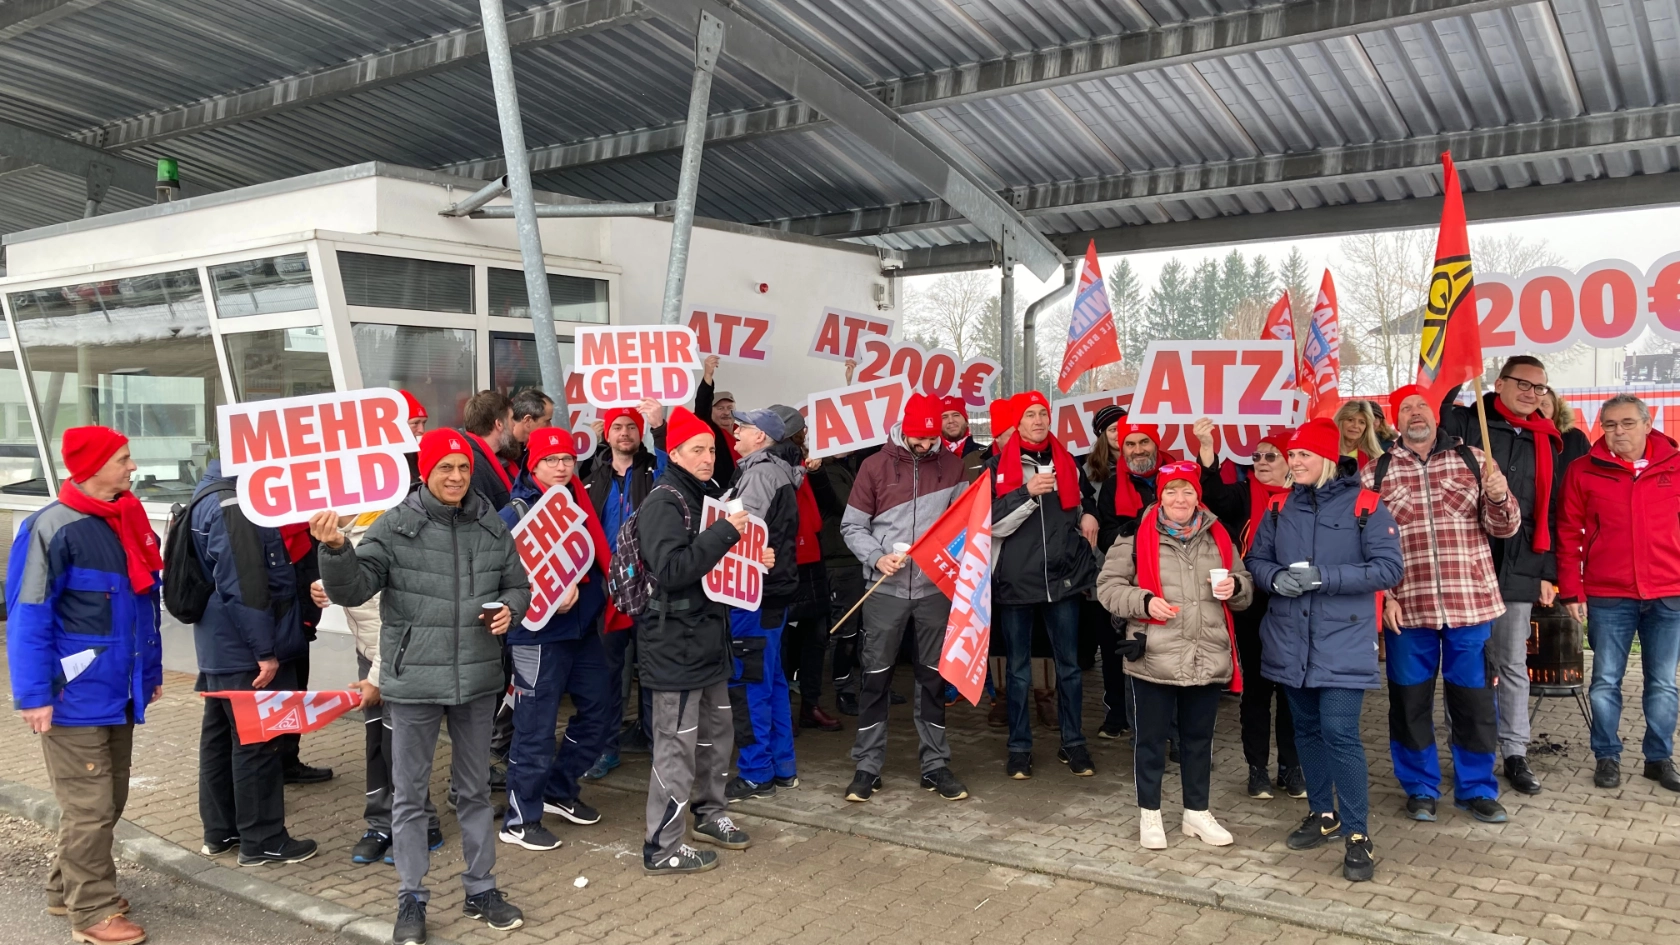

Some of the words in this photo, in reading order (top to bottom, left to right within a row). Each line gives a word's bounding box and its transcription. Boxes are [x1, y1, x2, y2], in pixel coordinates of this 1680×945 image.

[582, 332, 691, 366] MEHR
[688, 311, 768, 360] ATZ
[591, 367, 688, 402] GELD
[858, 341, 994, 406] 200€
[1140, 350, 1283, 415] ATZ
[229, 398, 404, 464] MEHR
[248, 453, 400, 517] GELD
[514, 492, 579, 575] EHR
[706, 556, 760, 604] GELD
